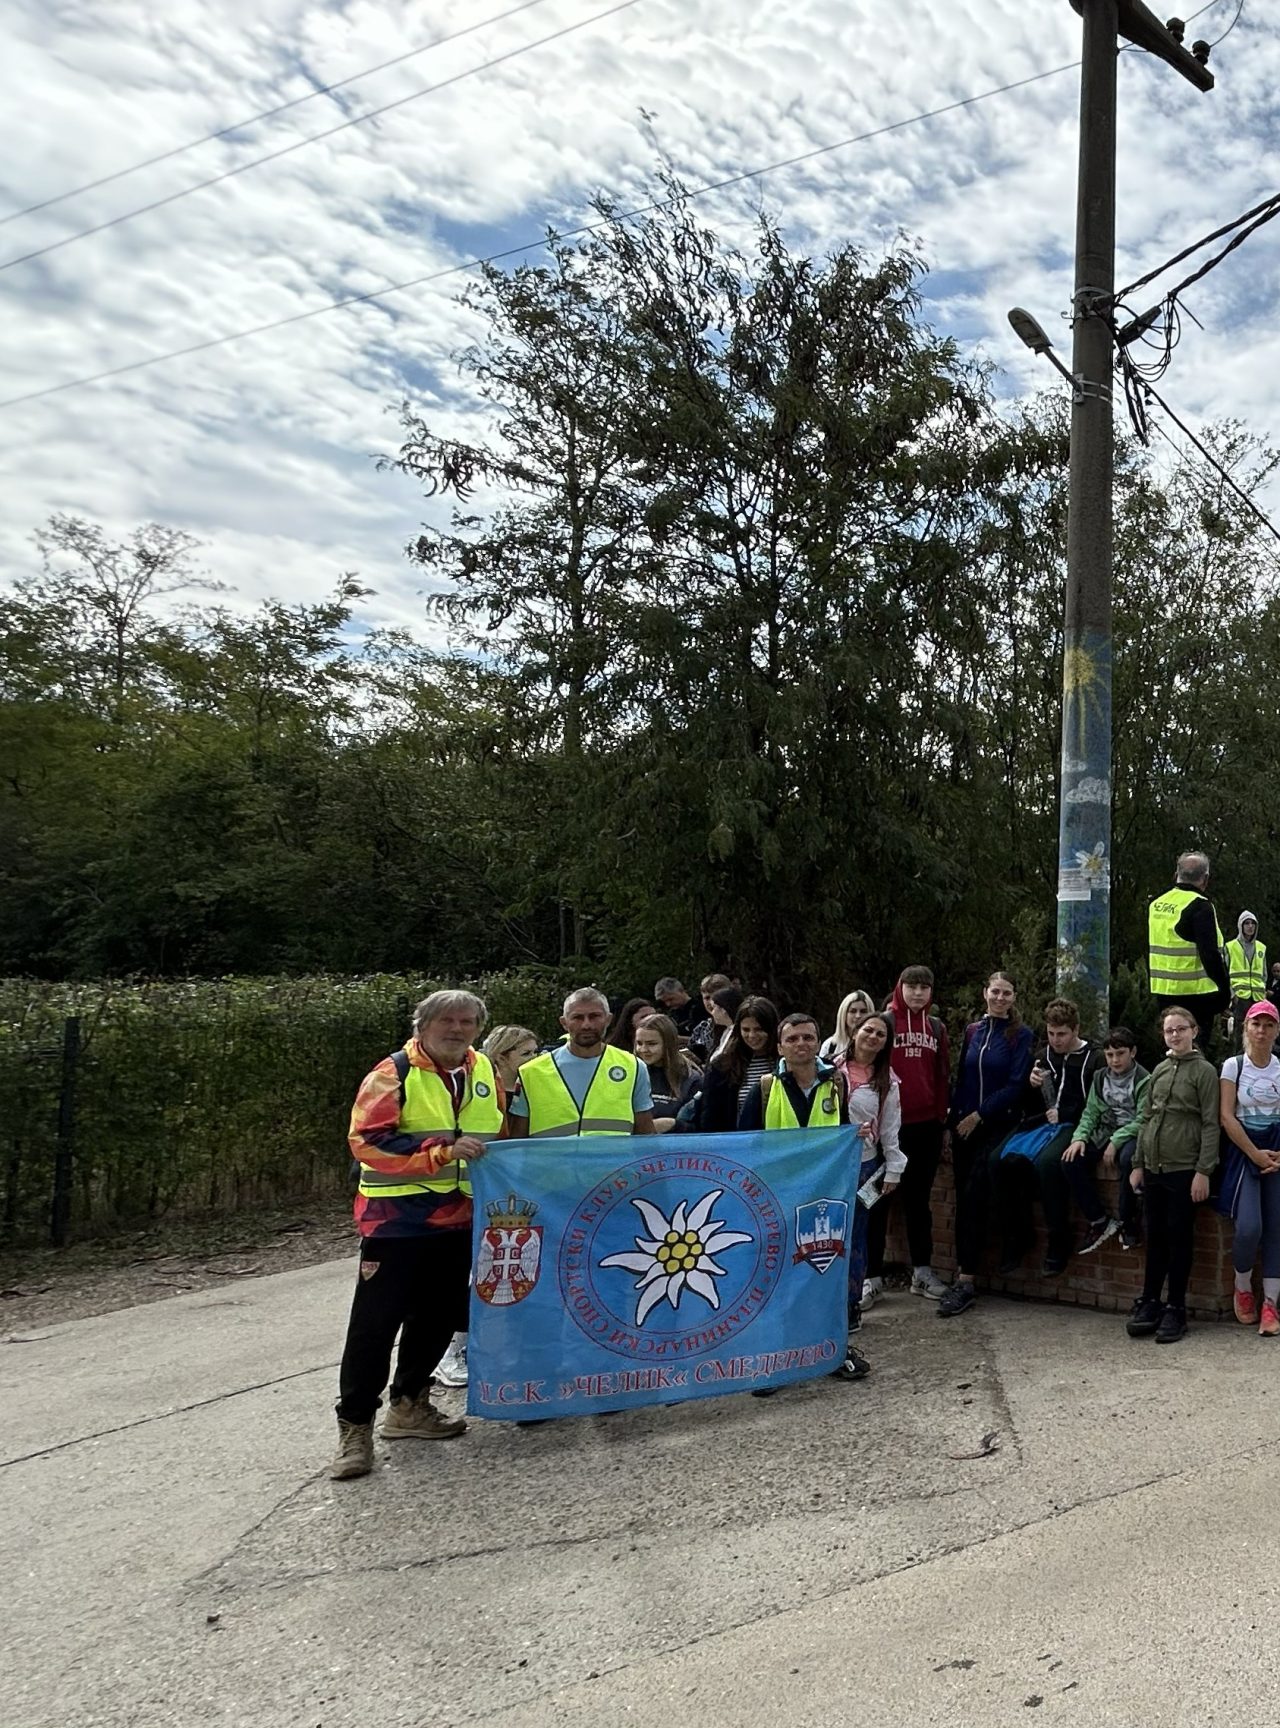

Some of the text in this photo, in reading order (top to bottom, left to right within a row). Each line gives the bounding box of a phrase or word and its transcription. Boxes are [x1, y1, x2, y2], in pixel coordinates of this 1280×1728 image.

[580, 1178, 628, 1223] КЛУБ
[727, 1169, 781, 1270] СМЕДЕРЕВО
[812, 1240, 833, 1250] 1430
[562, 1228, 609, 1333] СПОРТСКИ
[608, 1287, 766, 1354] ПЛАНИНАРСКИ
